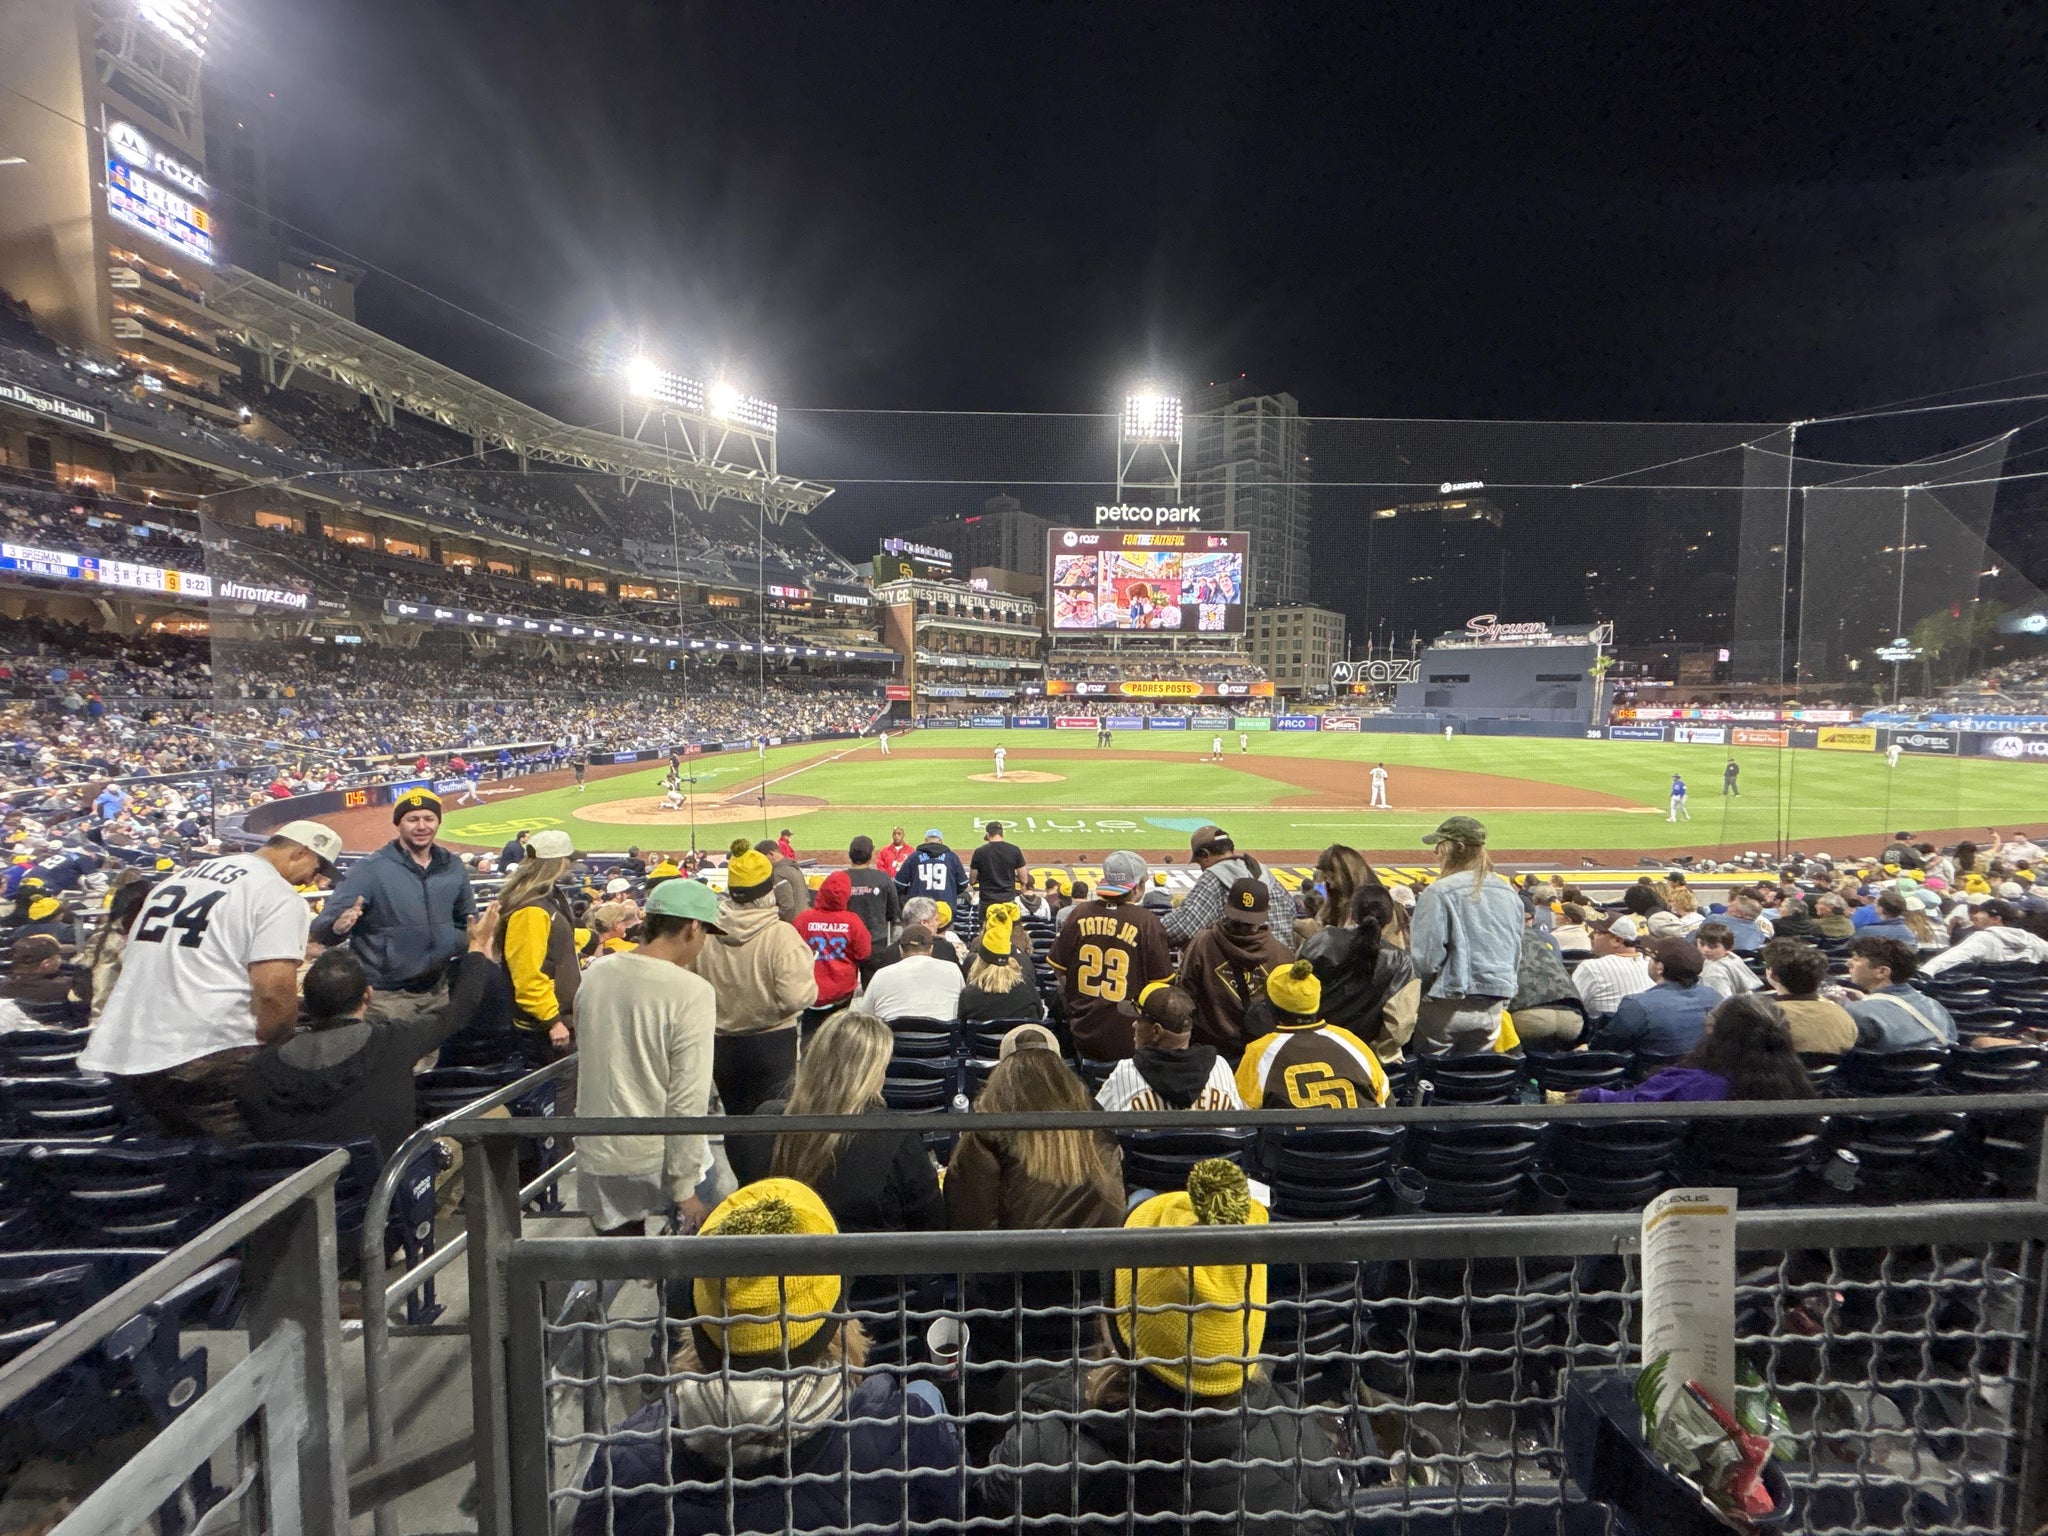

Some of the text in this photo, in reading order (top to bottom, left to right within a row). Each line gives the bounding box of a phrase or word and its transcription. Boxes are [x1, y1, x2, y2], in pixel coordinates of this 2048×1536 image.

[13, 385, 53, 411] Diego
[53, 399, 95, 425] Health
[1095, 503, 1201, 525] petco park
[1079, 534, 1100, 544] razr
[9, 546, 17, 557] 3
[168, 576, 176, 591] 9
[185, 578, 206, 591] 9:22
[220, 579, 308, 609] NITTOTIRE.COM
[833, 593, 869, 607] CUTWATER
[912, 587, 1036, 615] WESTERN METAL SUPPLY CO.
[1465, 614, 1548, 641] Sycuan
[939, 657, 958, 667] ORIS
[1087, 684, 1106, 692] razr
[1132, 683, 1192, 694] PADRES POSTS
[1229, 685, 1248, 693] razr
[959, 720, 970, 728] 342
[1278, 719, 1306, 728] ARCO
[1586, 730, 1602, 738] 396
[1896, 734, 1950, 747] EVOTEK
[973, 816, 1138, 829] blue
[918, 863, 948, 891] 49
[134, 884, 230, 949] 24
[808, 921, 850, 933] GONZALEZ
[1077, 915, 1140, 948] TATIS JR.
[1077, 943, 1130, 1002] 23
[1663, 1193, 1710, 1205] LEXUS
